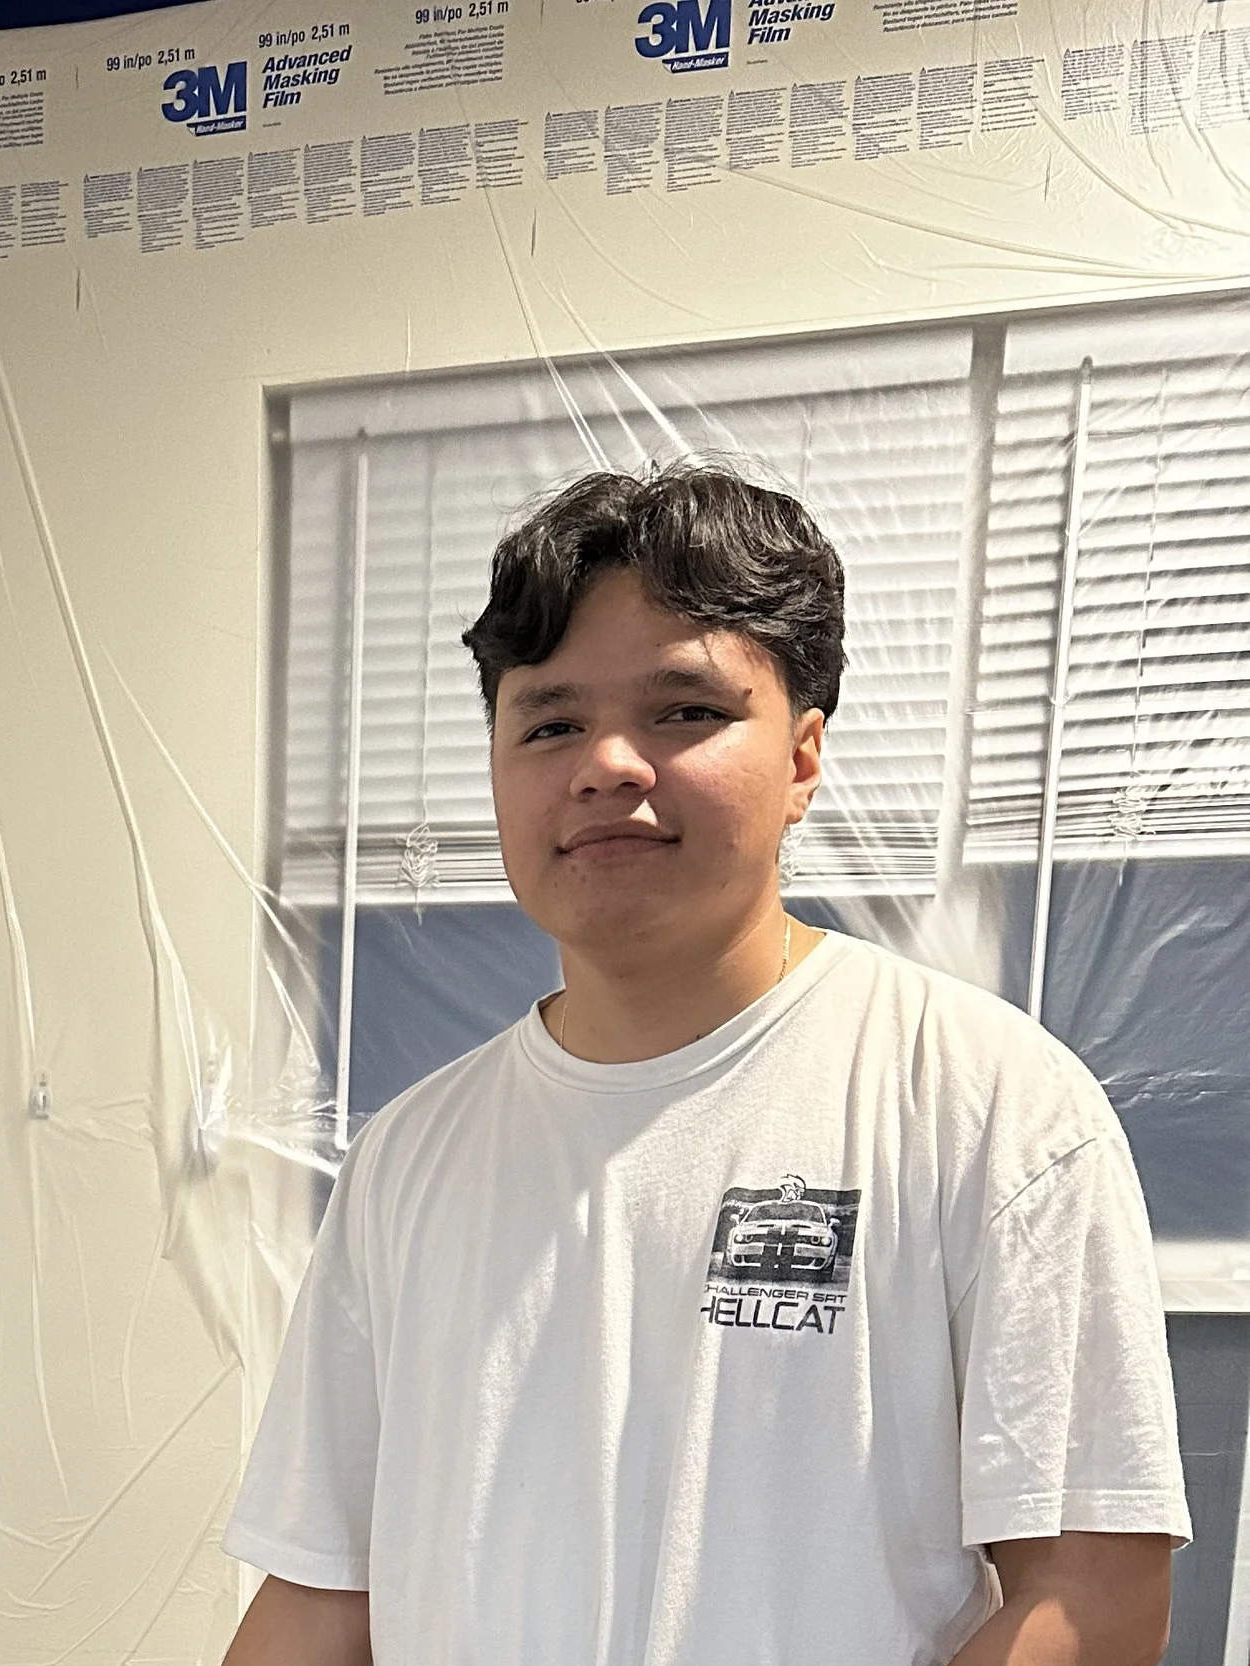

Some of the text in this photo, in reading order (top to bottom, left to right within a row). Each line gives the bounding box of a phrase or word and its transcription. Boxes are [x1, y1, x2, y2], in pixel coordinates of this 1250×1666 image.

[415, 0, 508, 24] 99 in/po 2,51 m
[749, 3, 835, 26] Masking
[258, 24, 350, 48] 99 in/po 2,51 m
[635, 0, 731, 58] 3M
[748, 26, 791, 45] Film
[107, 48, 195, 71] 99 in/po 2,51 m
[262, 45, 352, 74] Advanced
[11, 70, 33, 86] 2,51
[36, 70, 47, 81] m
[263, 67, 340, 92] Masking
[162, 61, 247, 122] 3M
[263, 90, 301, 109] Film
